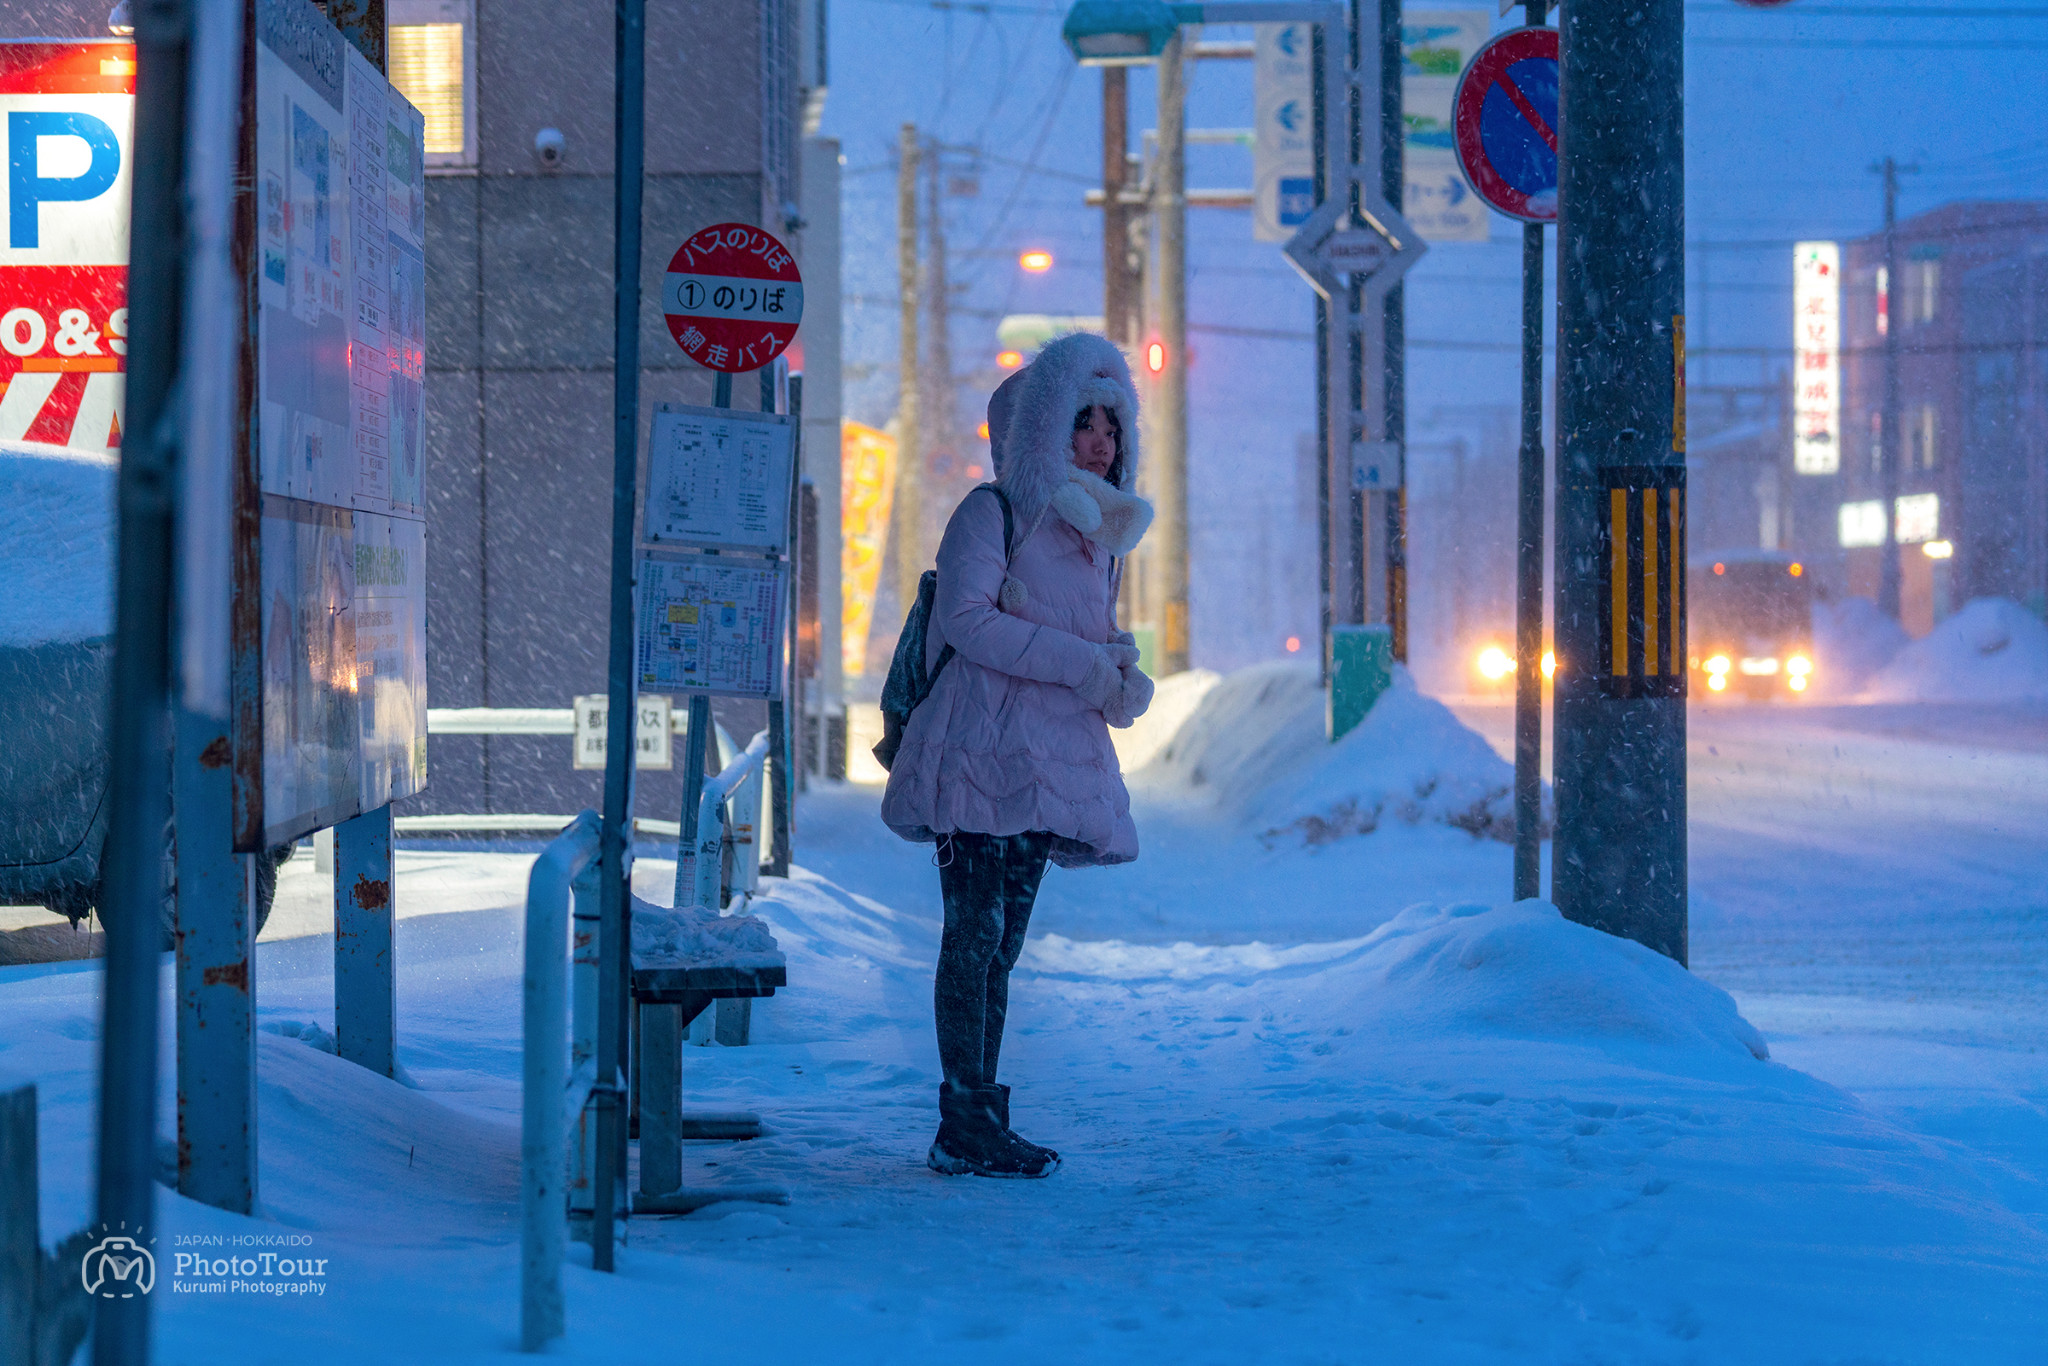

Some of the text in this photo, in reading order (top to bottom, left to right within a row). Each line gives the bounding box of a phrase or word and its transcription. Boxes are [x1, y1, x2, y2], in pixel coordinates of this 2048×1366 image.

[8, 111, 121, 249] P
[683, 228, 792, 272] バスのりば
[679, 326, 784, 368] 網走バス
